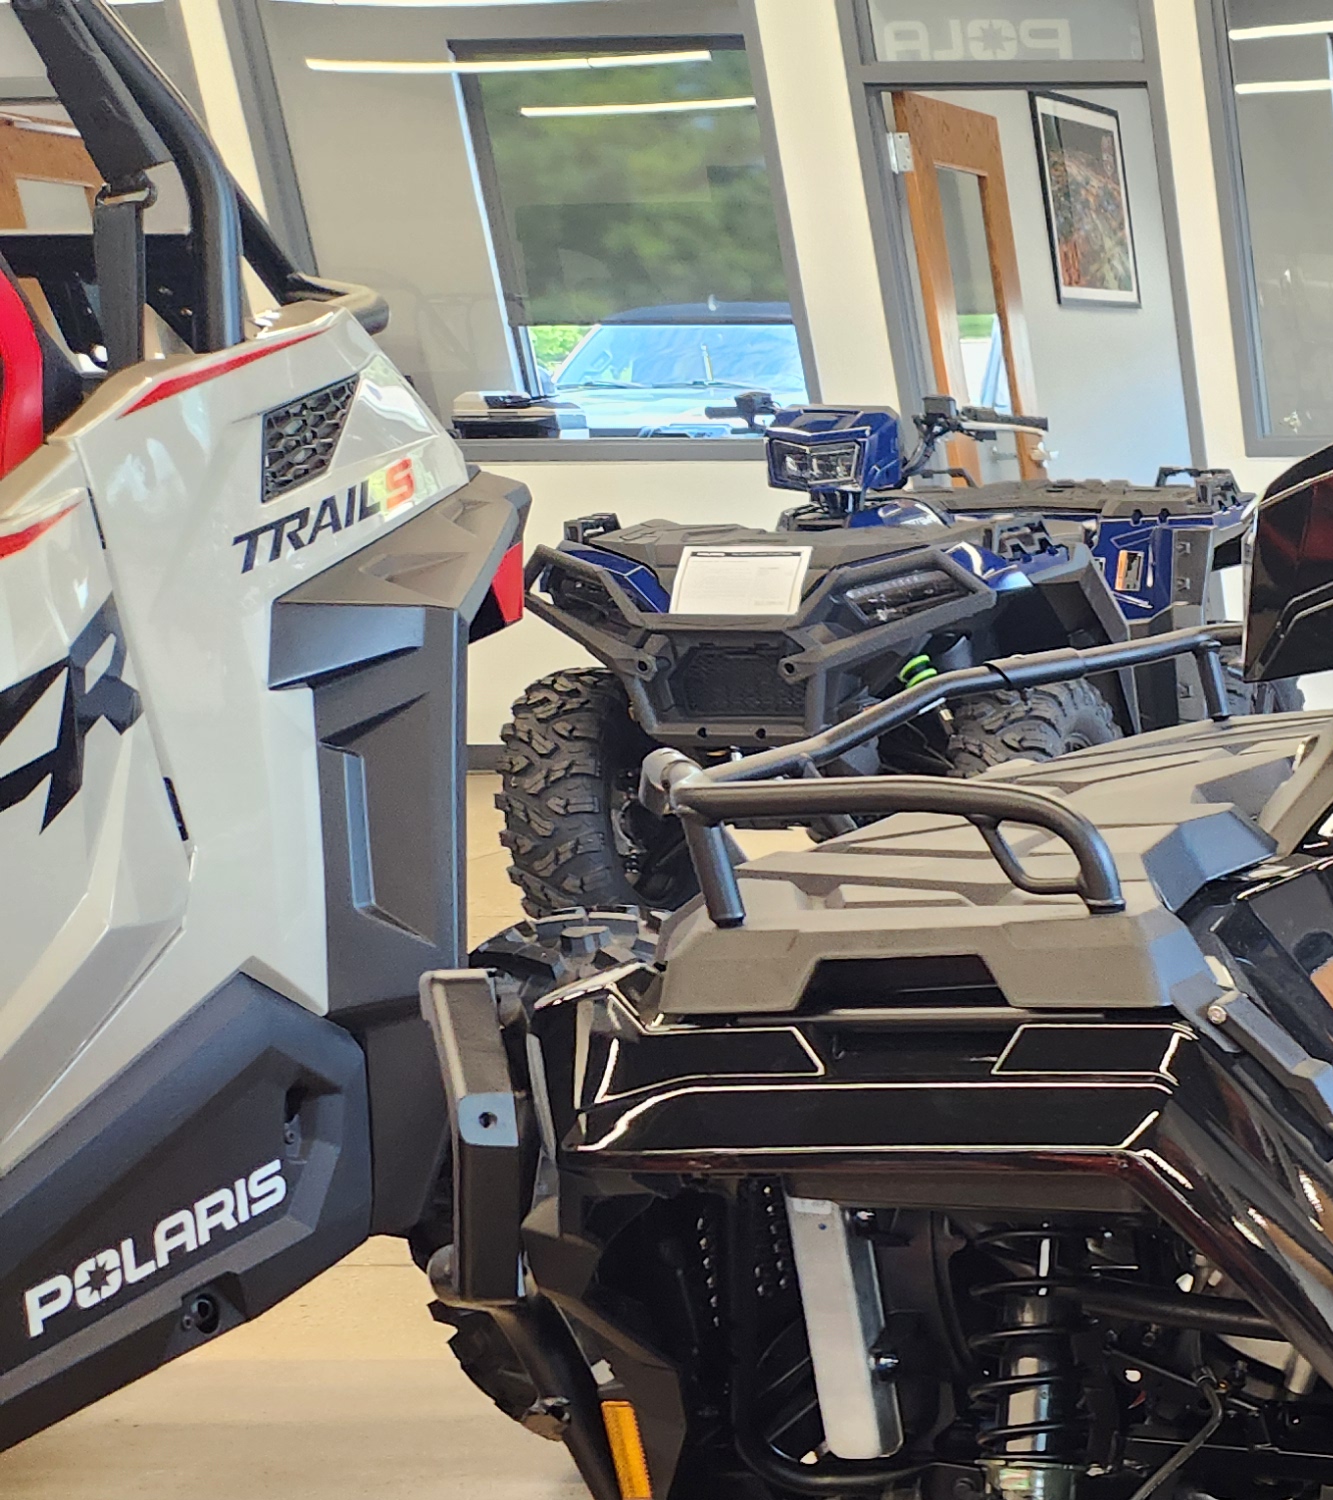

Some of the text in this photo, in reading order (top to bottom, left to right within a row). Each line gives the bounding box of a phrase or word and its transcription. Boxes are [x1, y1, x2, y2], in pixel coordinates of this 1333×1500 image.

[232, 458, 416, 574] TRAIL S
[24, 1158, 287, 1338] POLARIS
